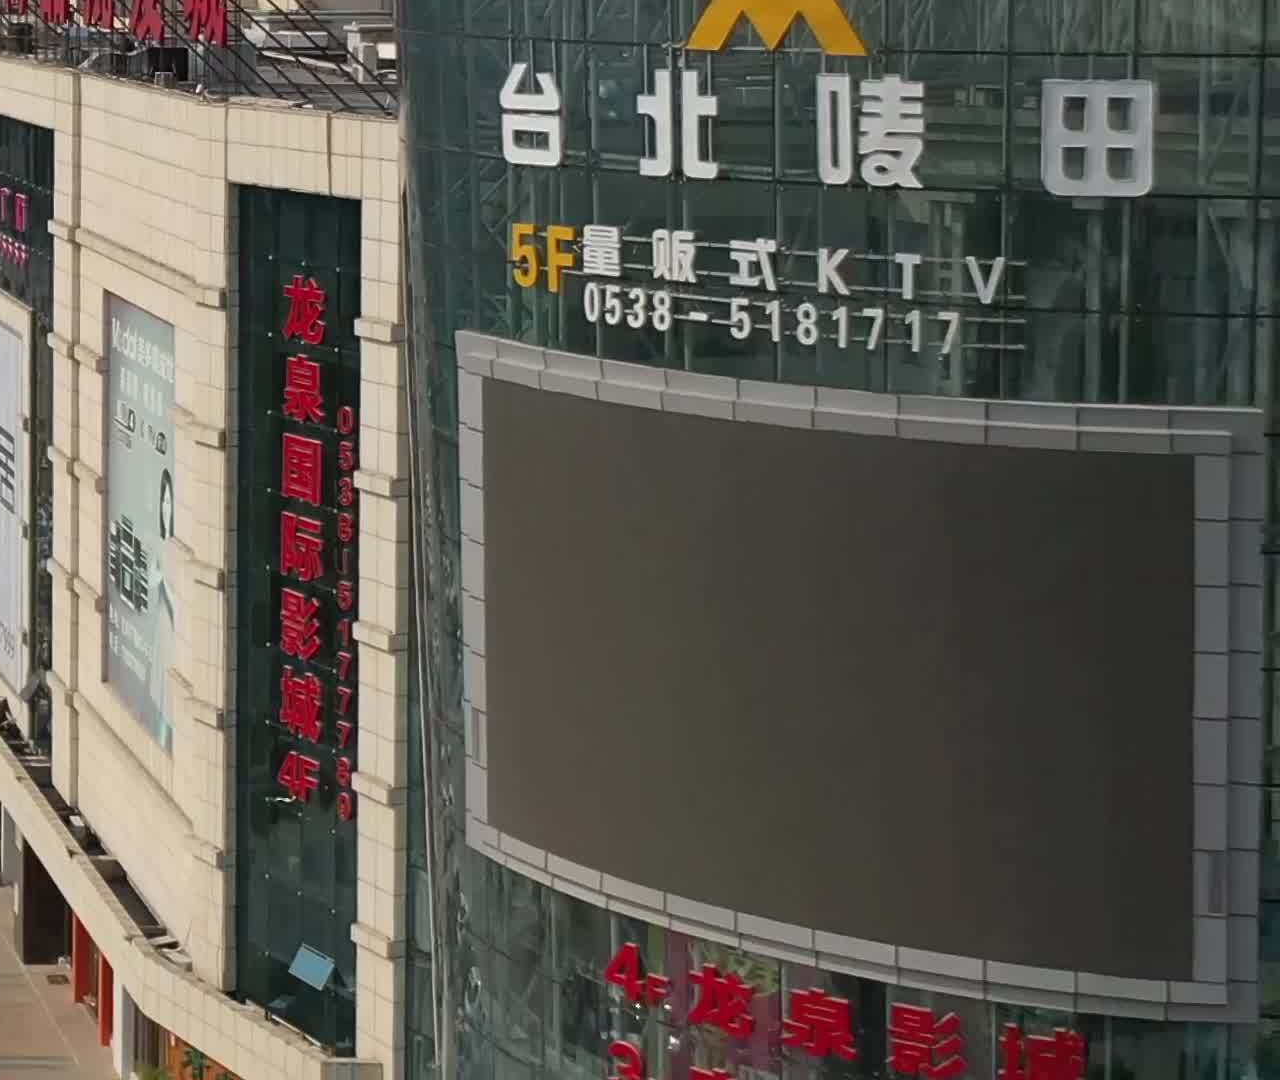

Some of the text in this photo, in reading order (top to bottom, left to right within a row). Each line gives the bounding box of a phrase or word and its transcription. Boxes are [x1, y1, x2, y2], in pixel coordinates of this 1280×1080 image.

[498, 62, 1156, 199] 台北唛田
[582, 283, 963, 355] 0538-5181717
